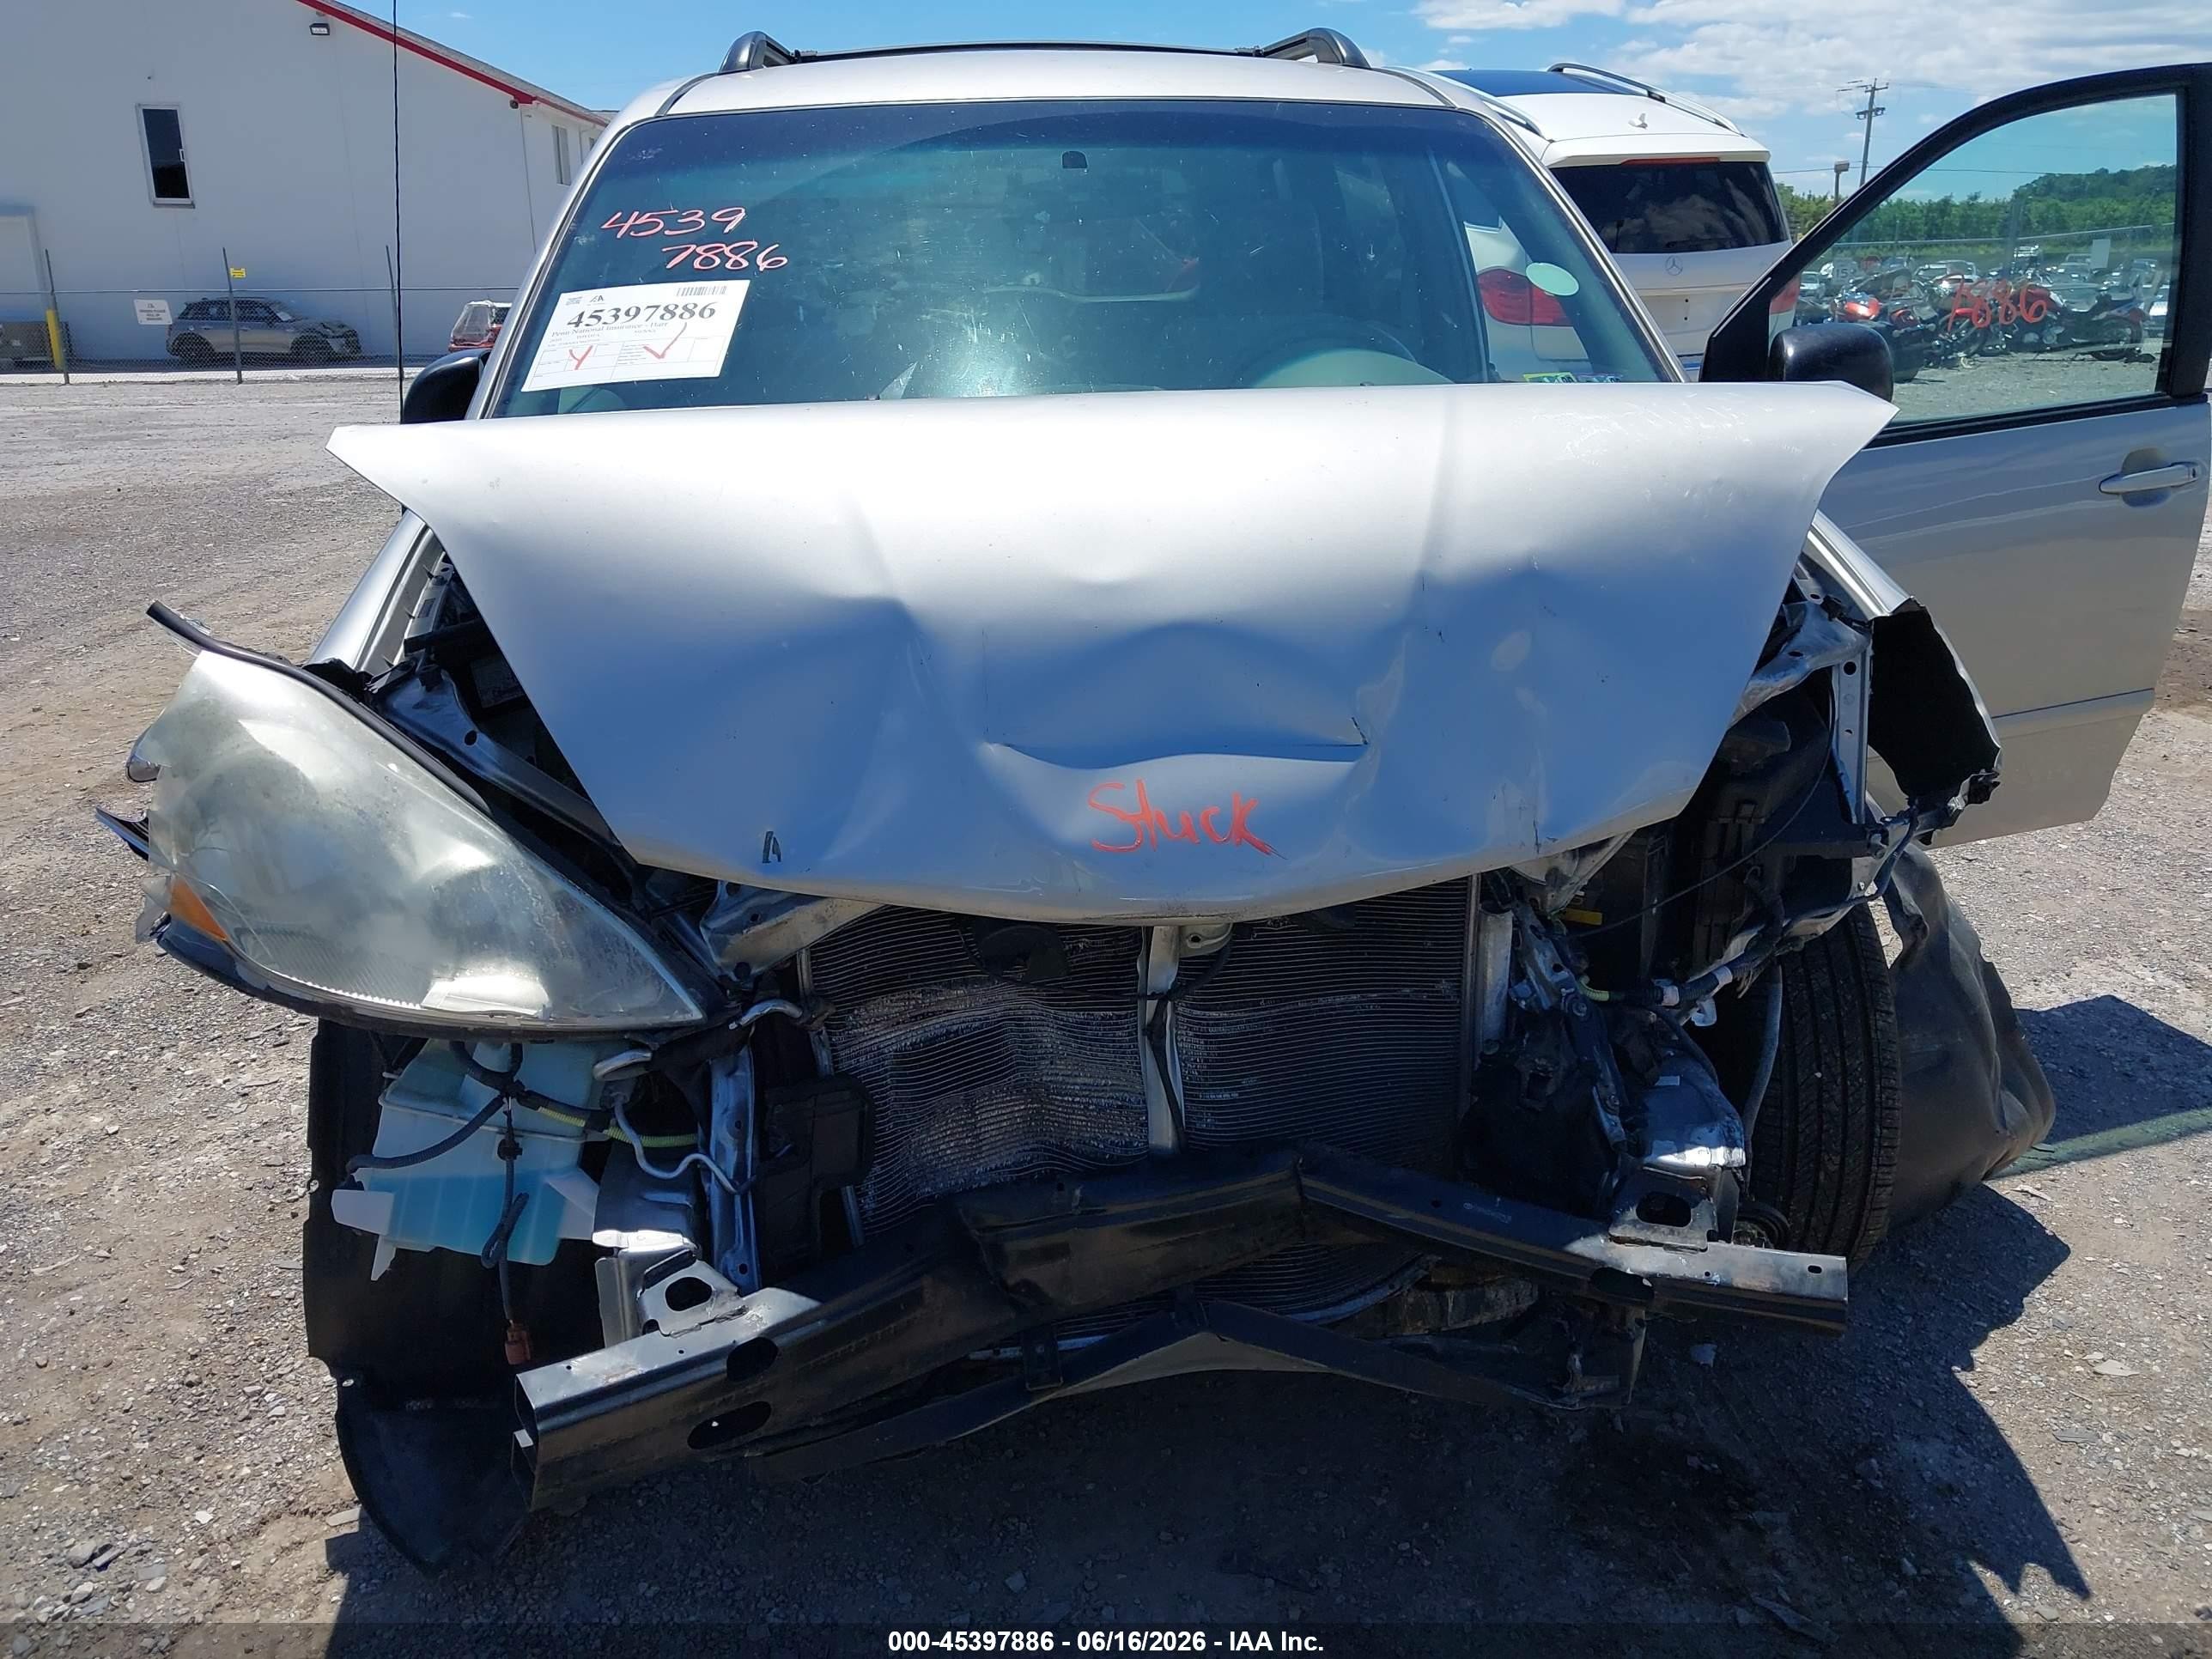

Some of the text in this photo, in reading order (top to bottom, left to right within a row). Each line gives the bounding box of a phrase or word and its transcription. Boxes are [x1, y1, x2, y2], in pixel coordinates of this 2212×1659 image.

[600, 207, 746, 239] 4539
[661, 240, 788, 271] 7886
[567, 301, 717, 328] 45397886
[1087, 778, 1275, 855] Stuck
